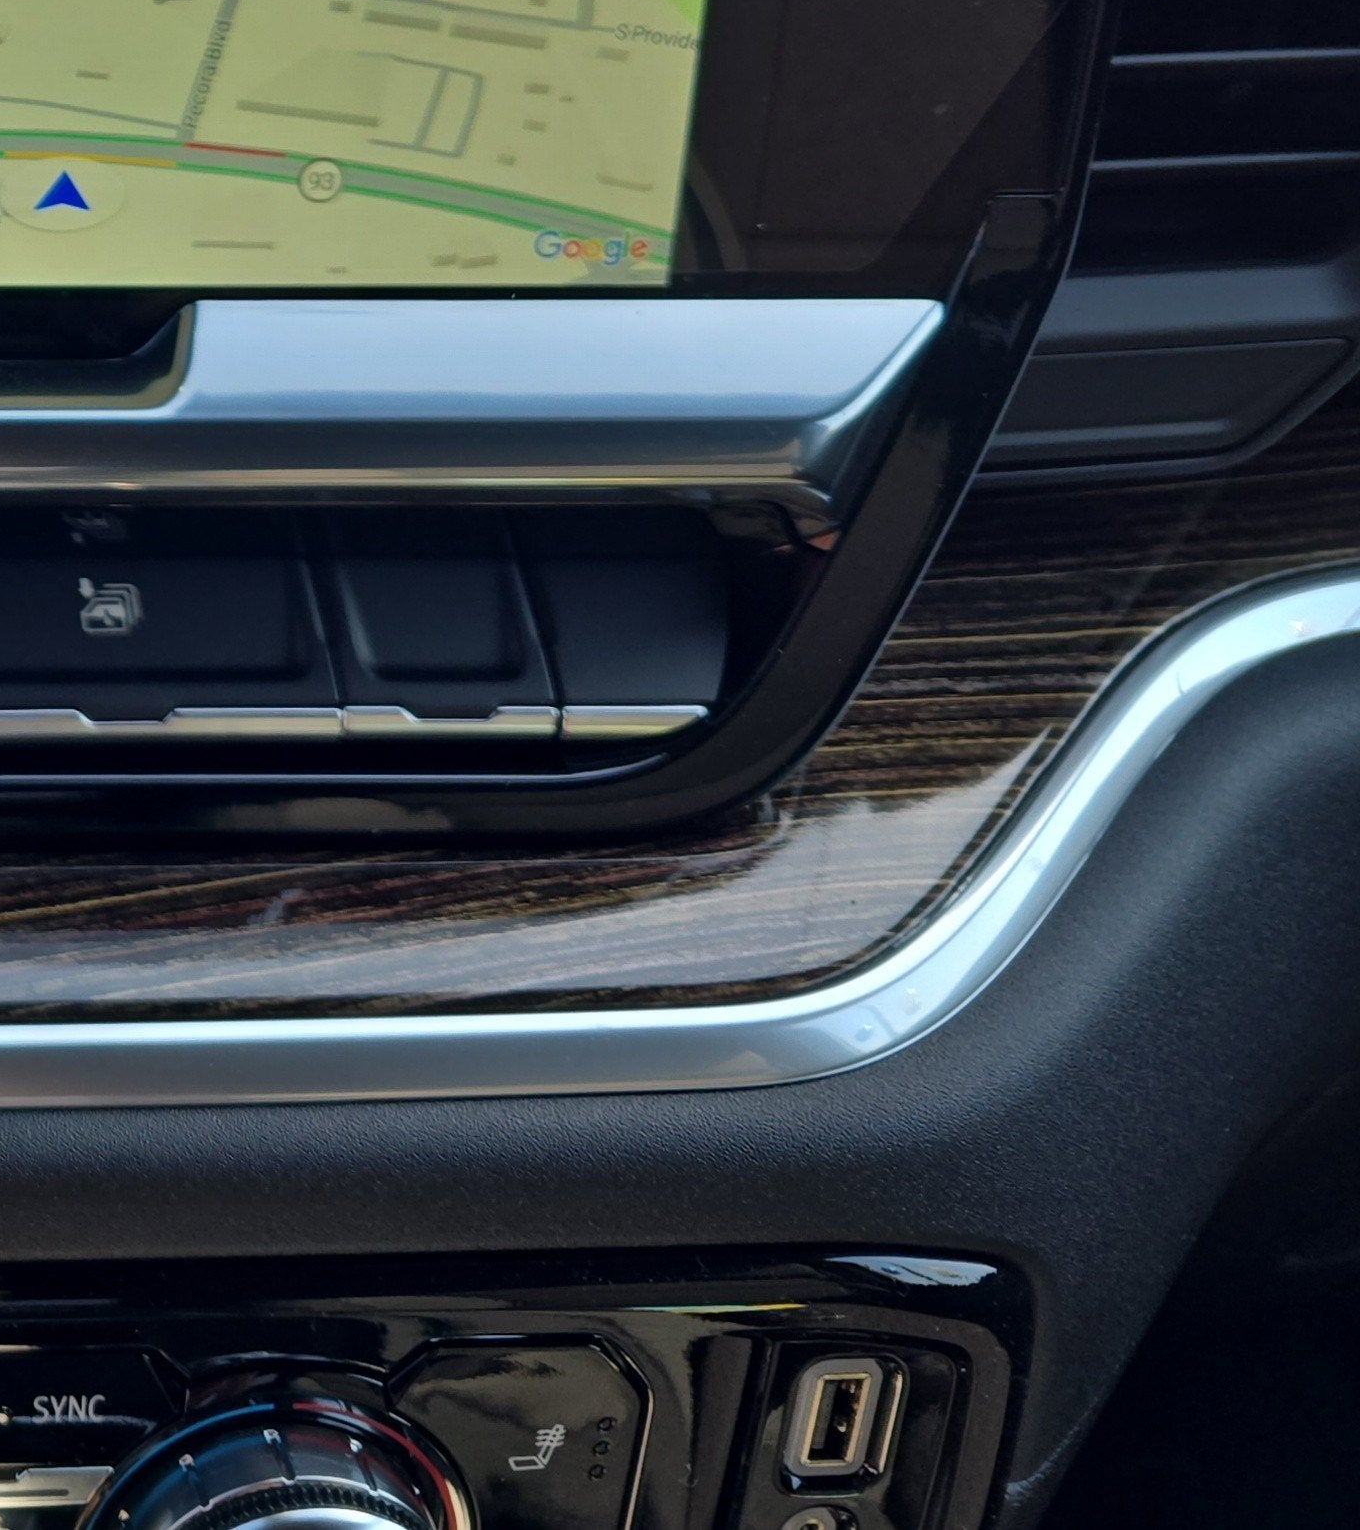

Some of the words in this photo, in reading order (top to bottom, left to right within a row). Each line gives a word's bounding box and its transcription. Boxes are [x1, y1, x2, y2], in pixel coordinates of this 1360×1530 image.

[614, 22, 628, 41] S
[308, 171, 335, 192] 93
[533, 230, 649, 266] Google
[32, 1394, 107, 1424] SYNC
